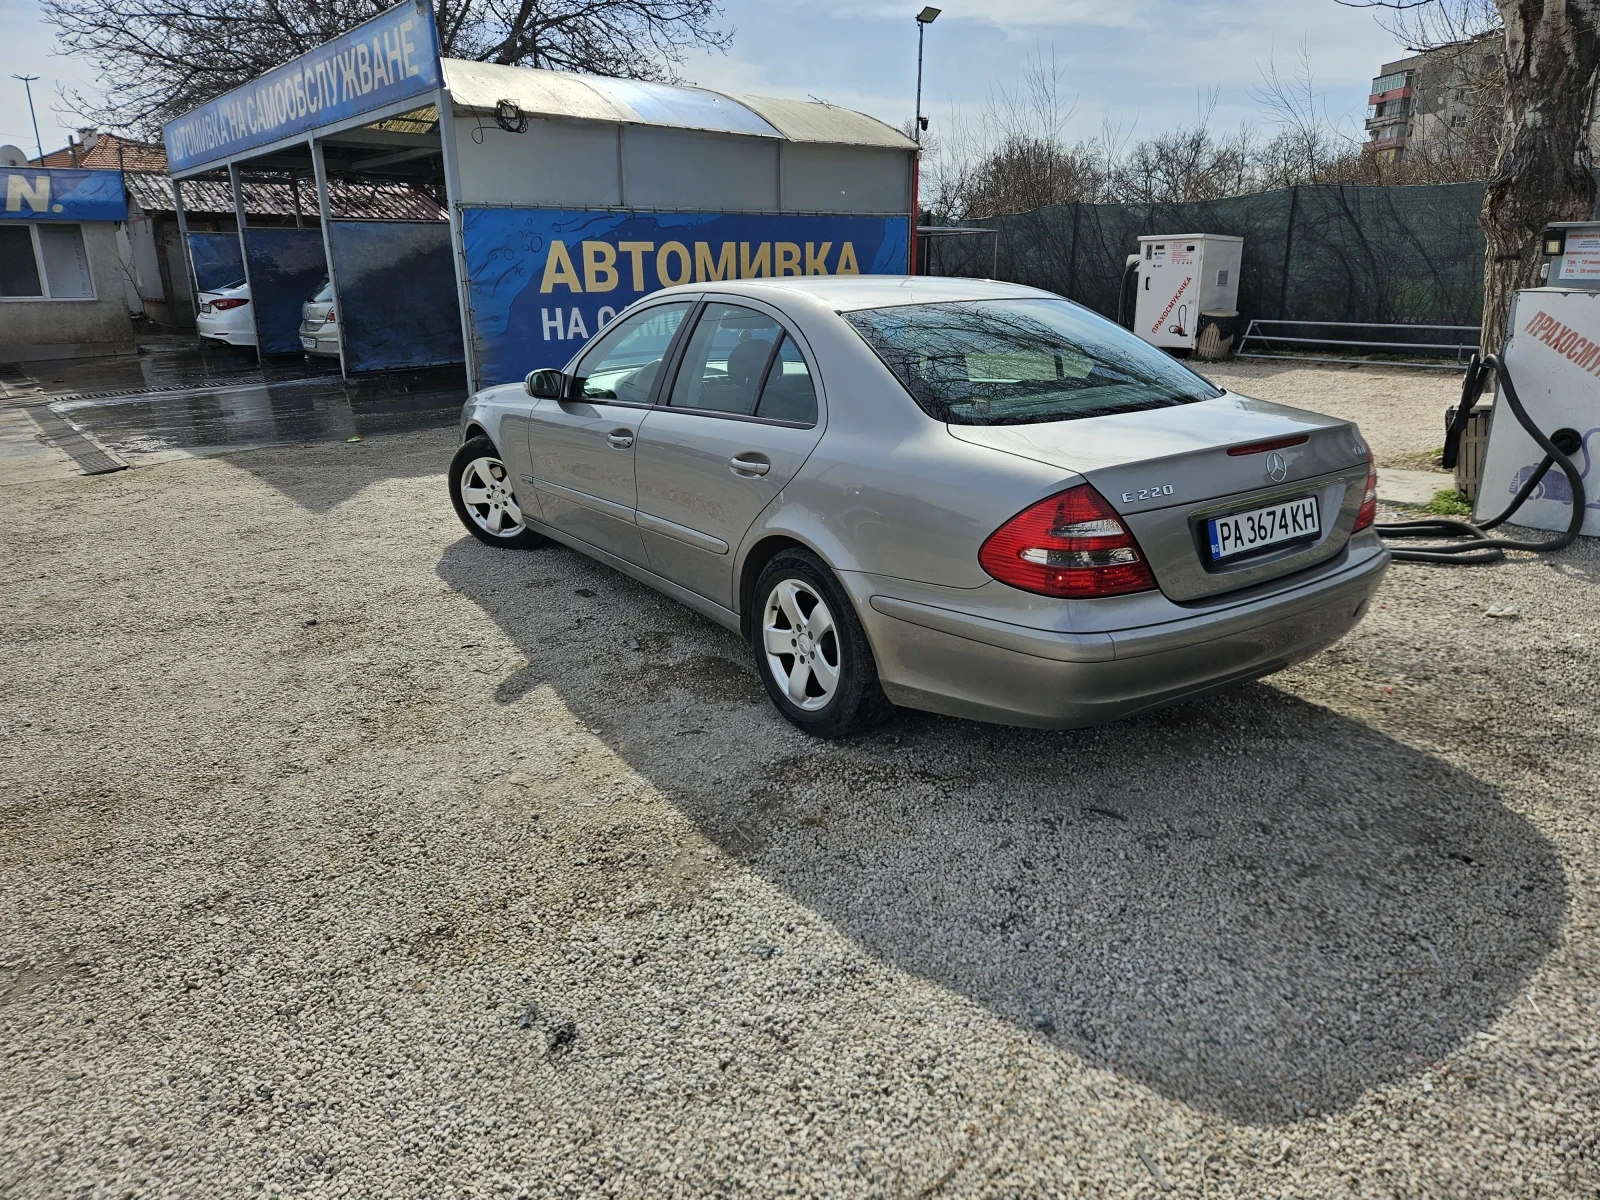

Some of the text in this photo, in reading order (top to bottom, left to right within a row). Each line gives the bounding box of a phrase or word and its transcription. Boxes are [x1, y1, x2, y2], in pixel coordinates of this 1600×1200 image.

[170, 20, 418, 161] АВТОМИВКА НА САМООБСЛУЖВАНЕ
[540, 240, 860, 293] АВТОМИВКА
[541, 306, 589, 340] НА
[1151, 276, 1192, 334] ПРАХОСМУКАЧКА
[1524, 310, 1600, 379] ПРАХОСМУ
[1121, 484, 1174, 503] E 220
[1211, 543, 1220, 554] BG
